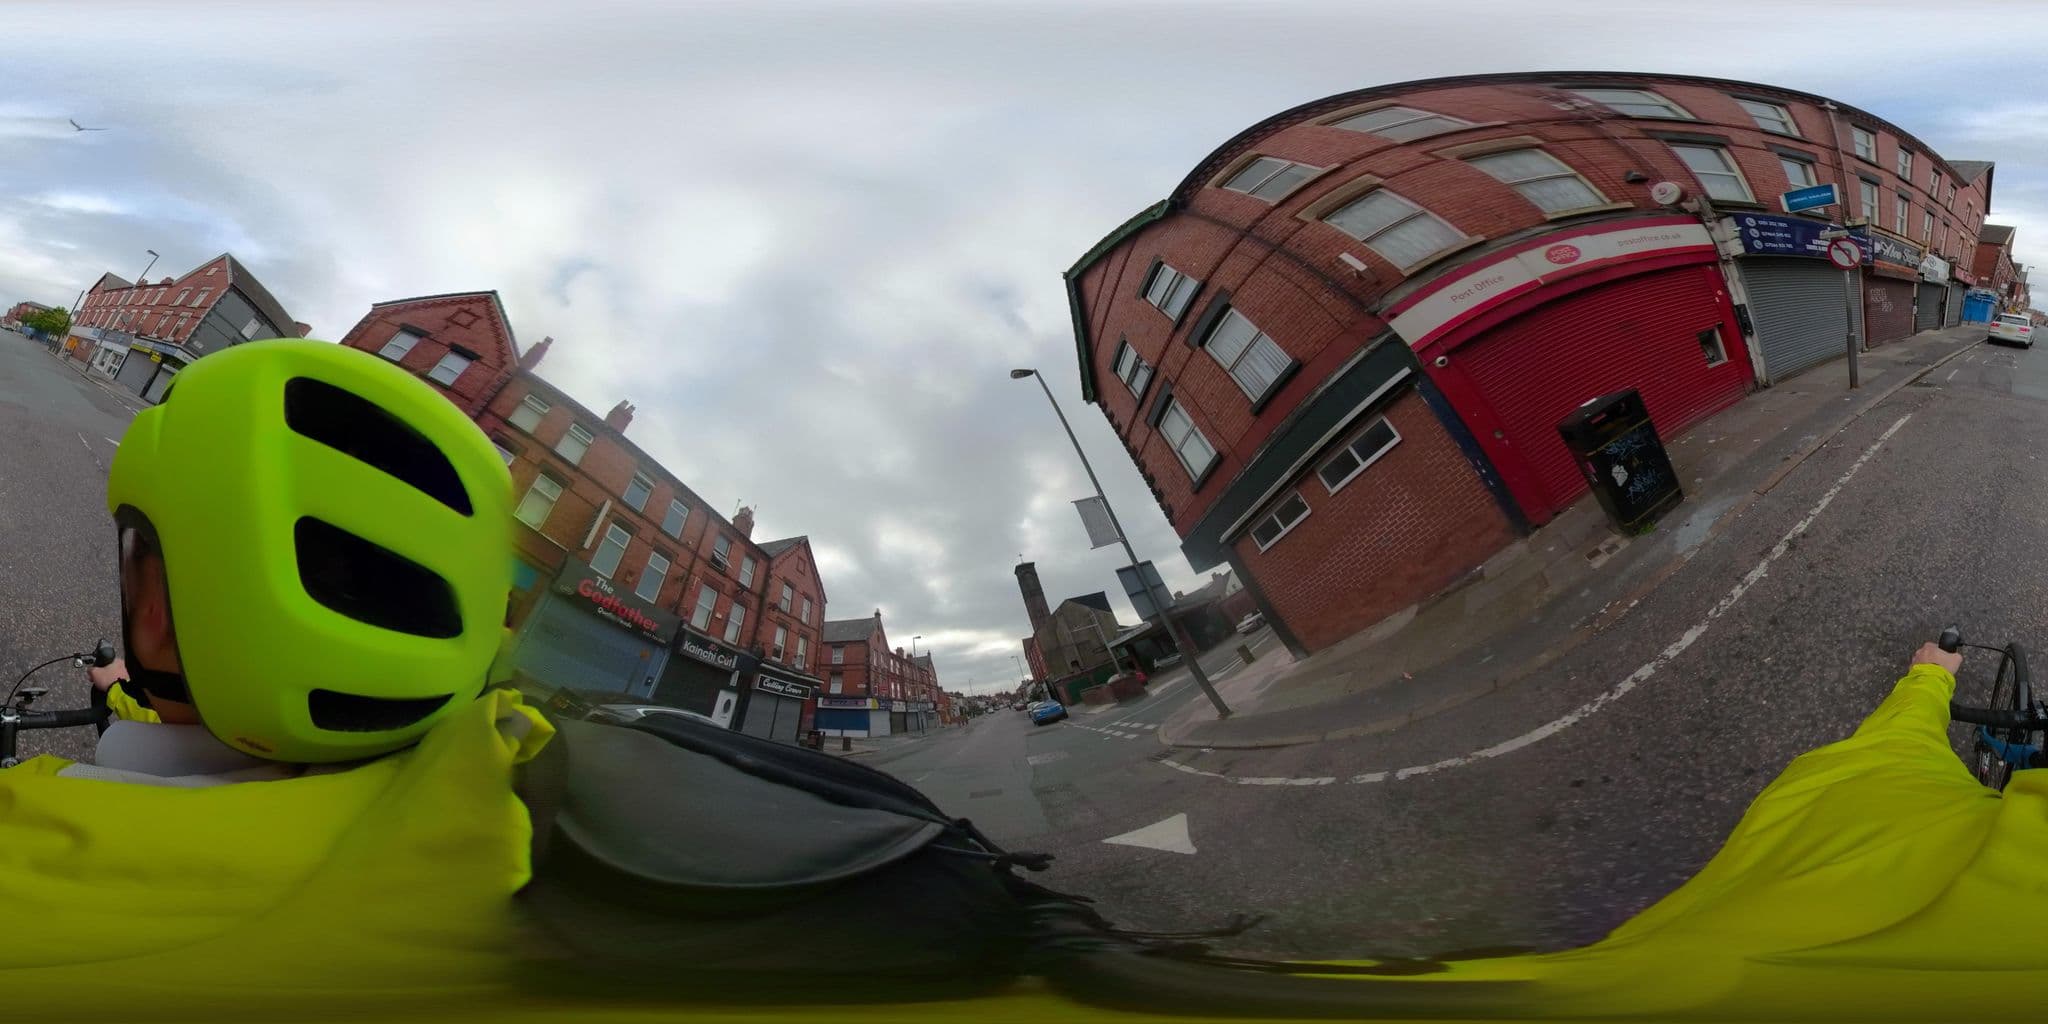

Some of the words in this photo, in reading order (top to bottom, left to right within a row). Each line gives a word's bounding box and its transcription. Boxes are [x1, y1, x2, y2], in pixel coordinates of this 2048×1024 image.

[1451, 287, 1473, 304] Post
[1474, 274, 1505, 292] Office
[595, 576, 614, 594] The
[578, 579, 657, 631] Godfather
[683, 640, 717, 662] Kainchi
